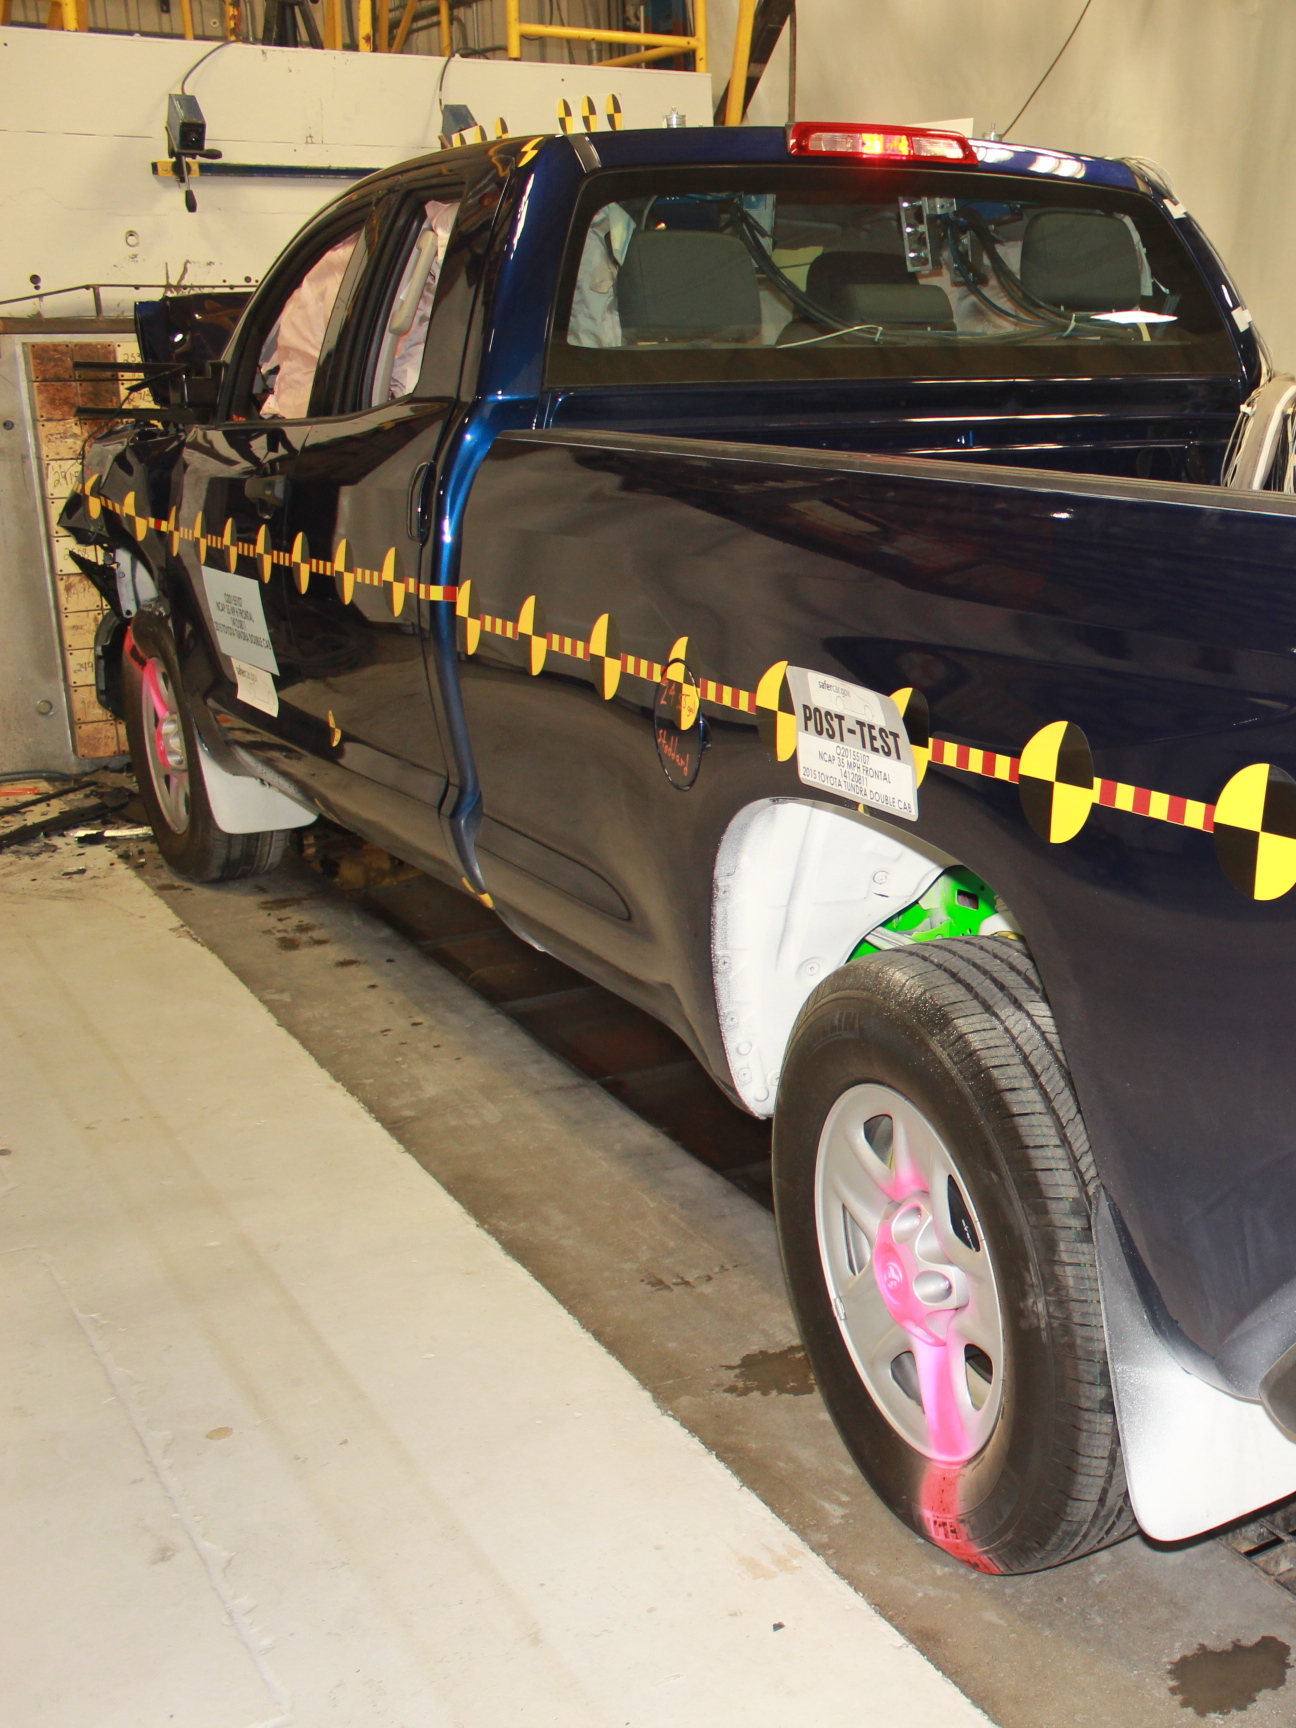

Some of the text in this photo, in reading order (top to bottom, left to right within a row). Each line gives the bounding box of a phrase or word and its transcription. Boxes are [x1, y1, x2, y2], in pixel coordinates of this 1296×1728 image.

[802, 703, 902, 761] POST-TEST
[818, 750, 891, 784] NCAP 35 MPH FRONTAL
[840, 768, 868, 787] 14120811
[802, 766, 912, 814] 2015 TOYOTA TUNDRA DOUBLE CAB
